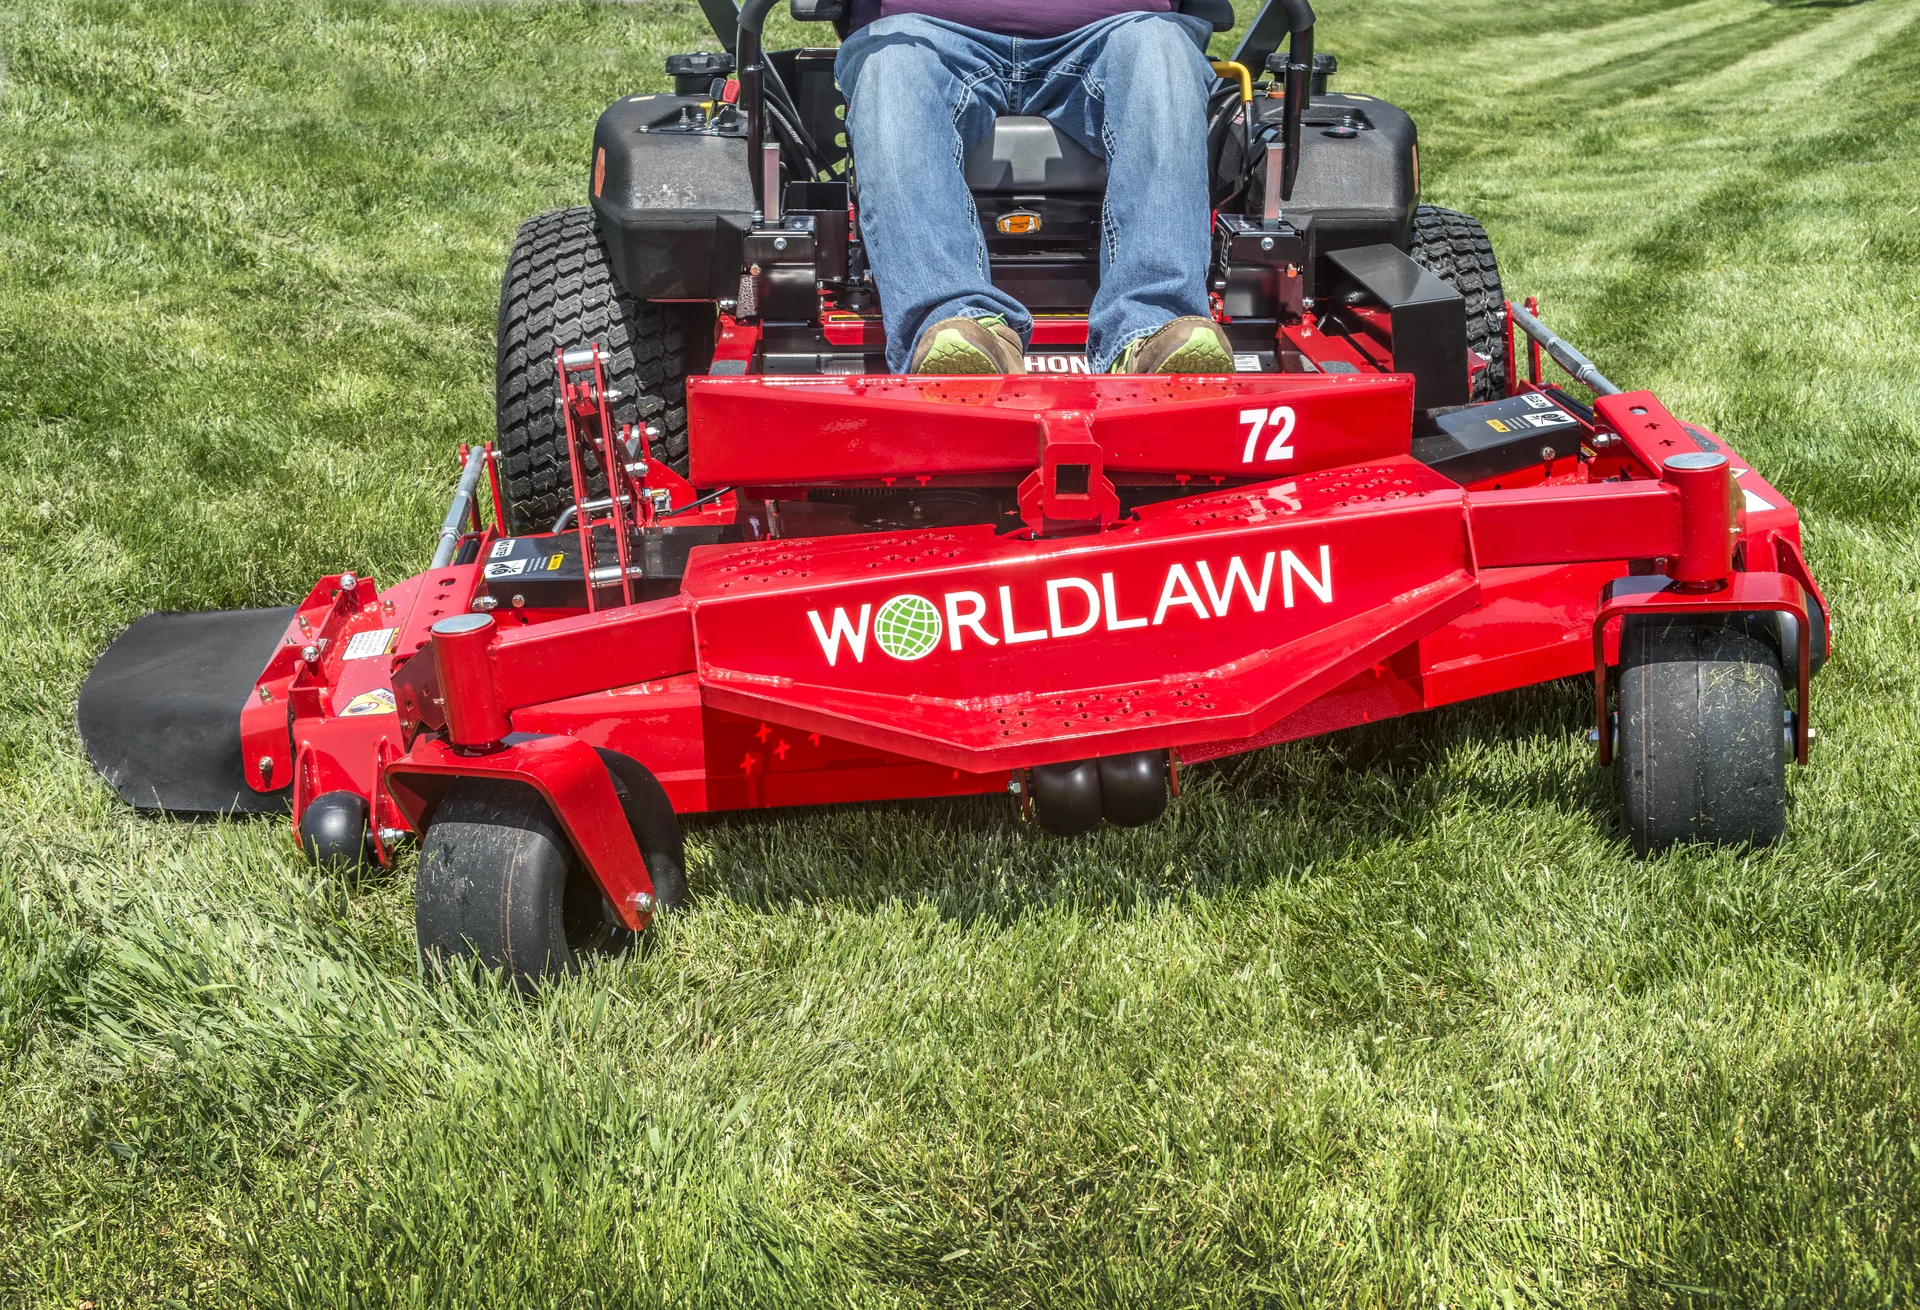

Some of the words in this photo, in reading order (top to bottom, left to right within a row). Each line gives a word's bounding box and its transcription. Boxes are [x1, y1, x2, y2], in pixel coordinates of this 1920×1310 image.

[1024, 356, 1092, 374] HON
[1239, 405, 1296, 464] 72
[806, 544, 1333, 667] WORLDLAWN
